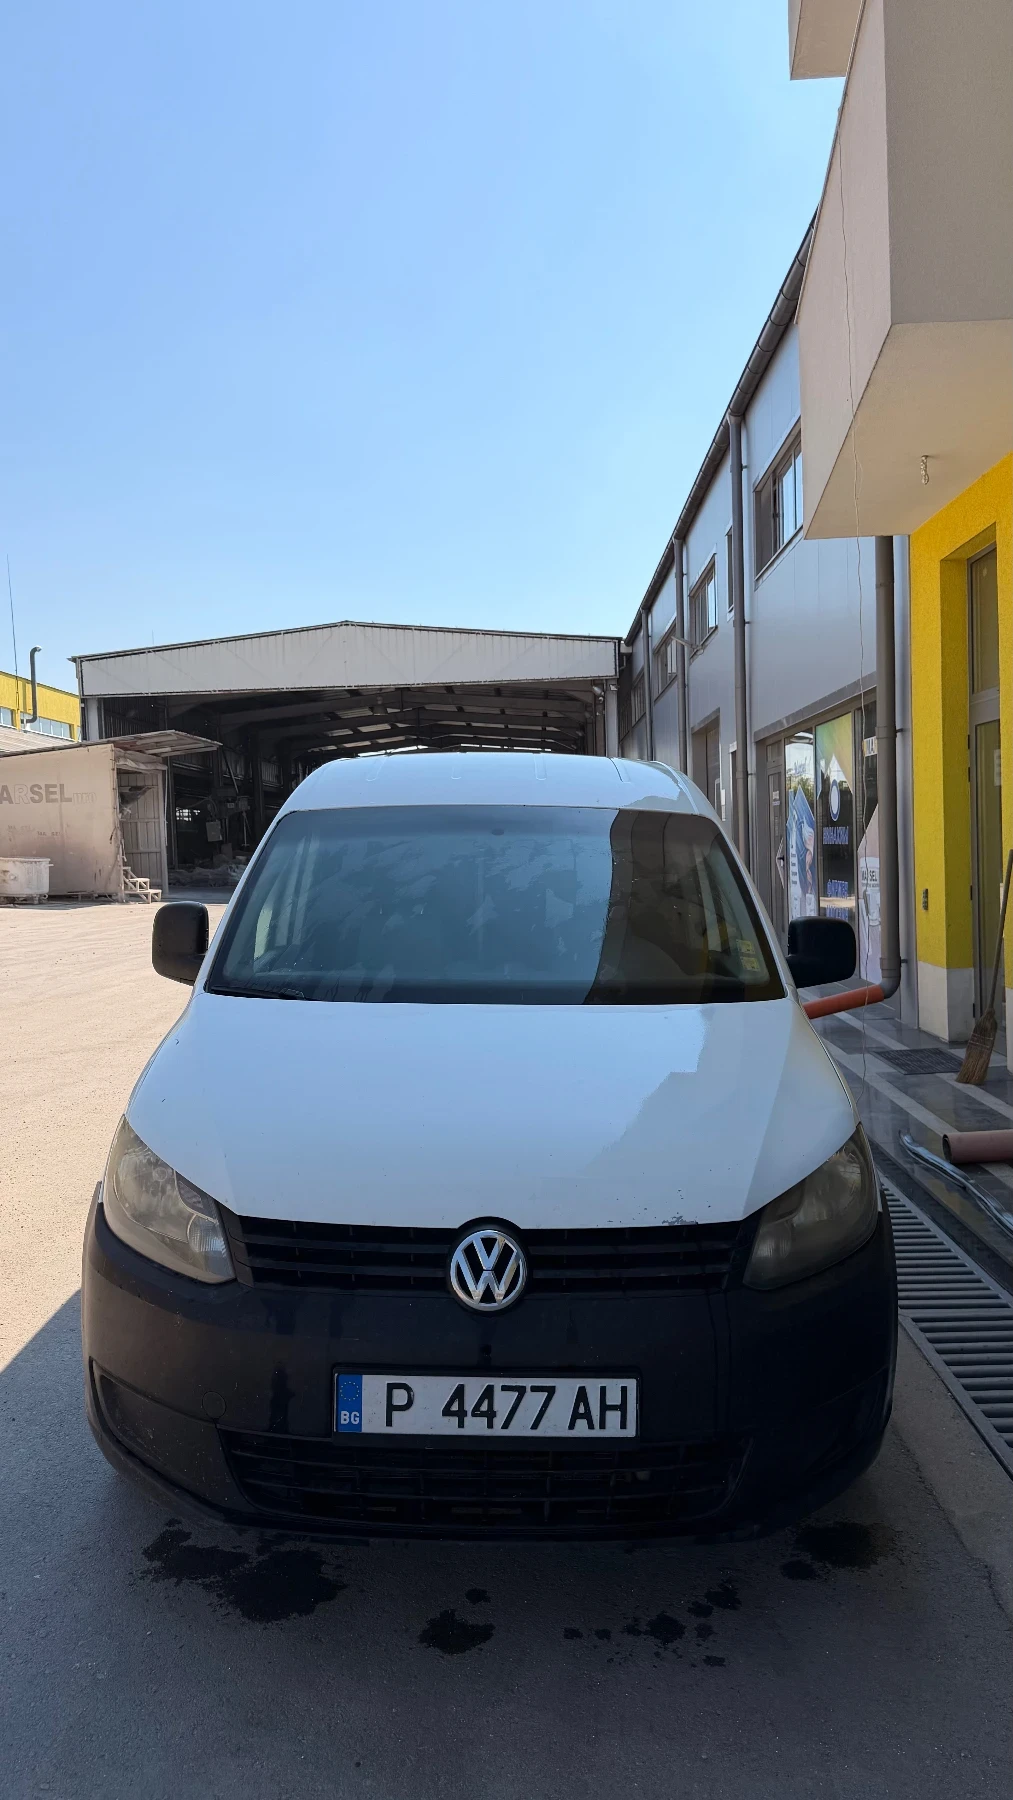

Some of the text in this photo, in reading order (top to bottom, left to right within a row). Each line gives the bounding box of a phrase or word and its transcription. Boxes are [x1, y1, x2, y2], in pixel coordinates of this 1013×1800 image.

[340, 1410, 360, 1425] BG
[385, 1382, 628, 1431] P 4477 AH
